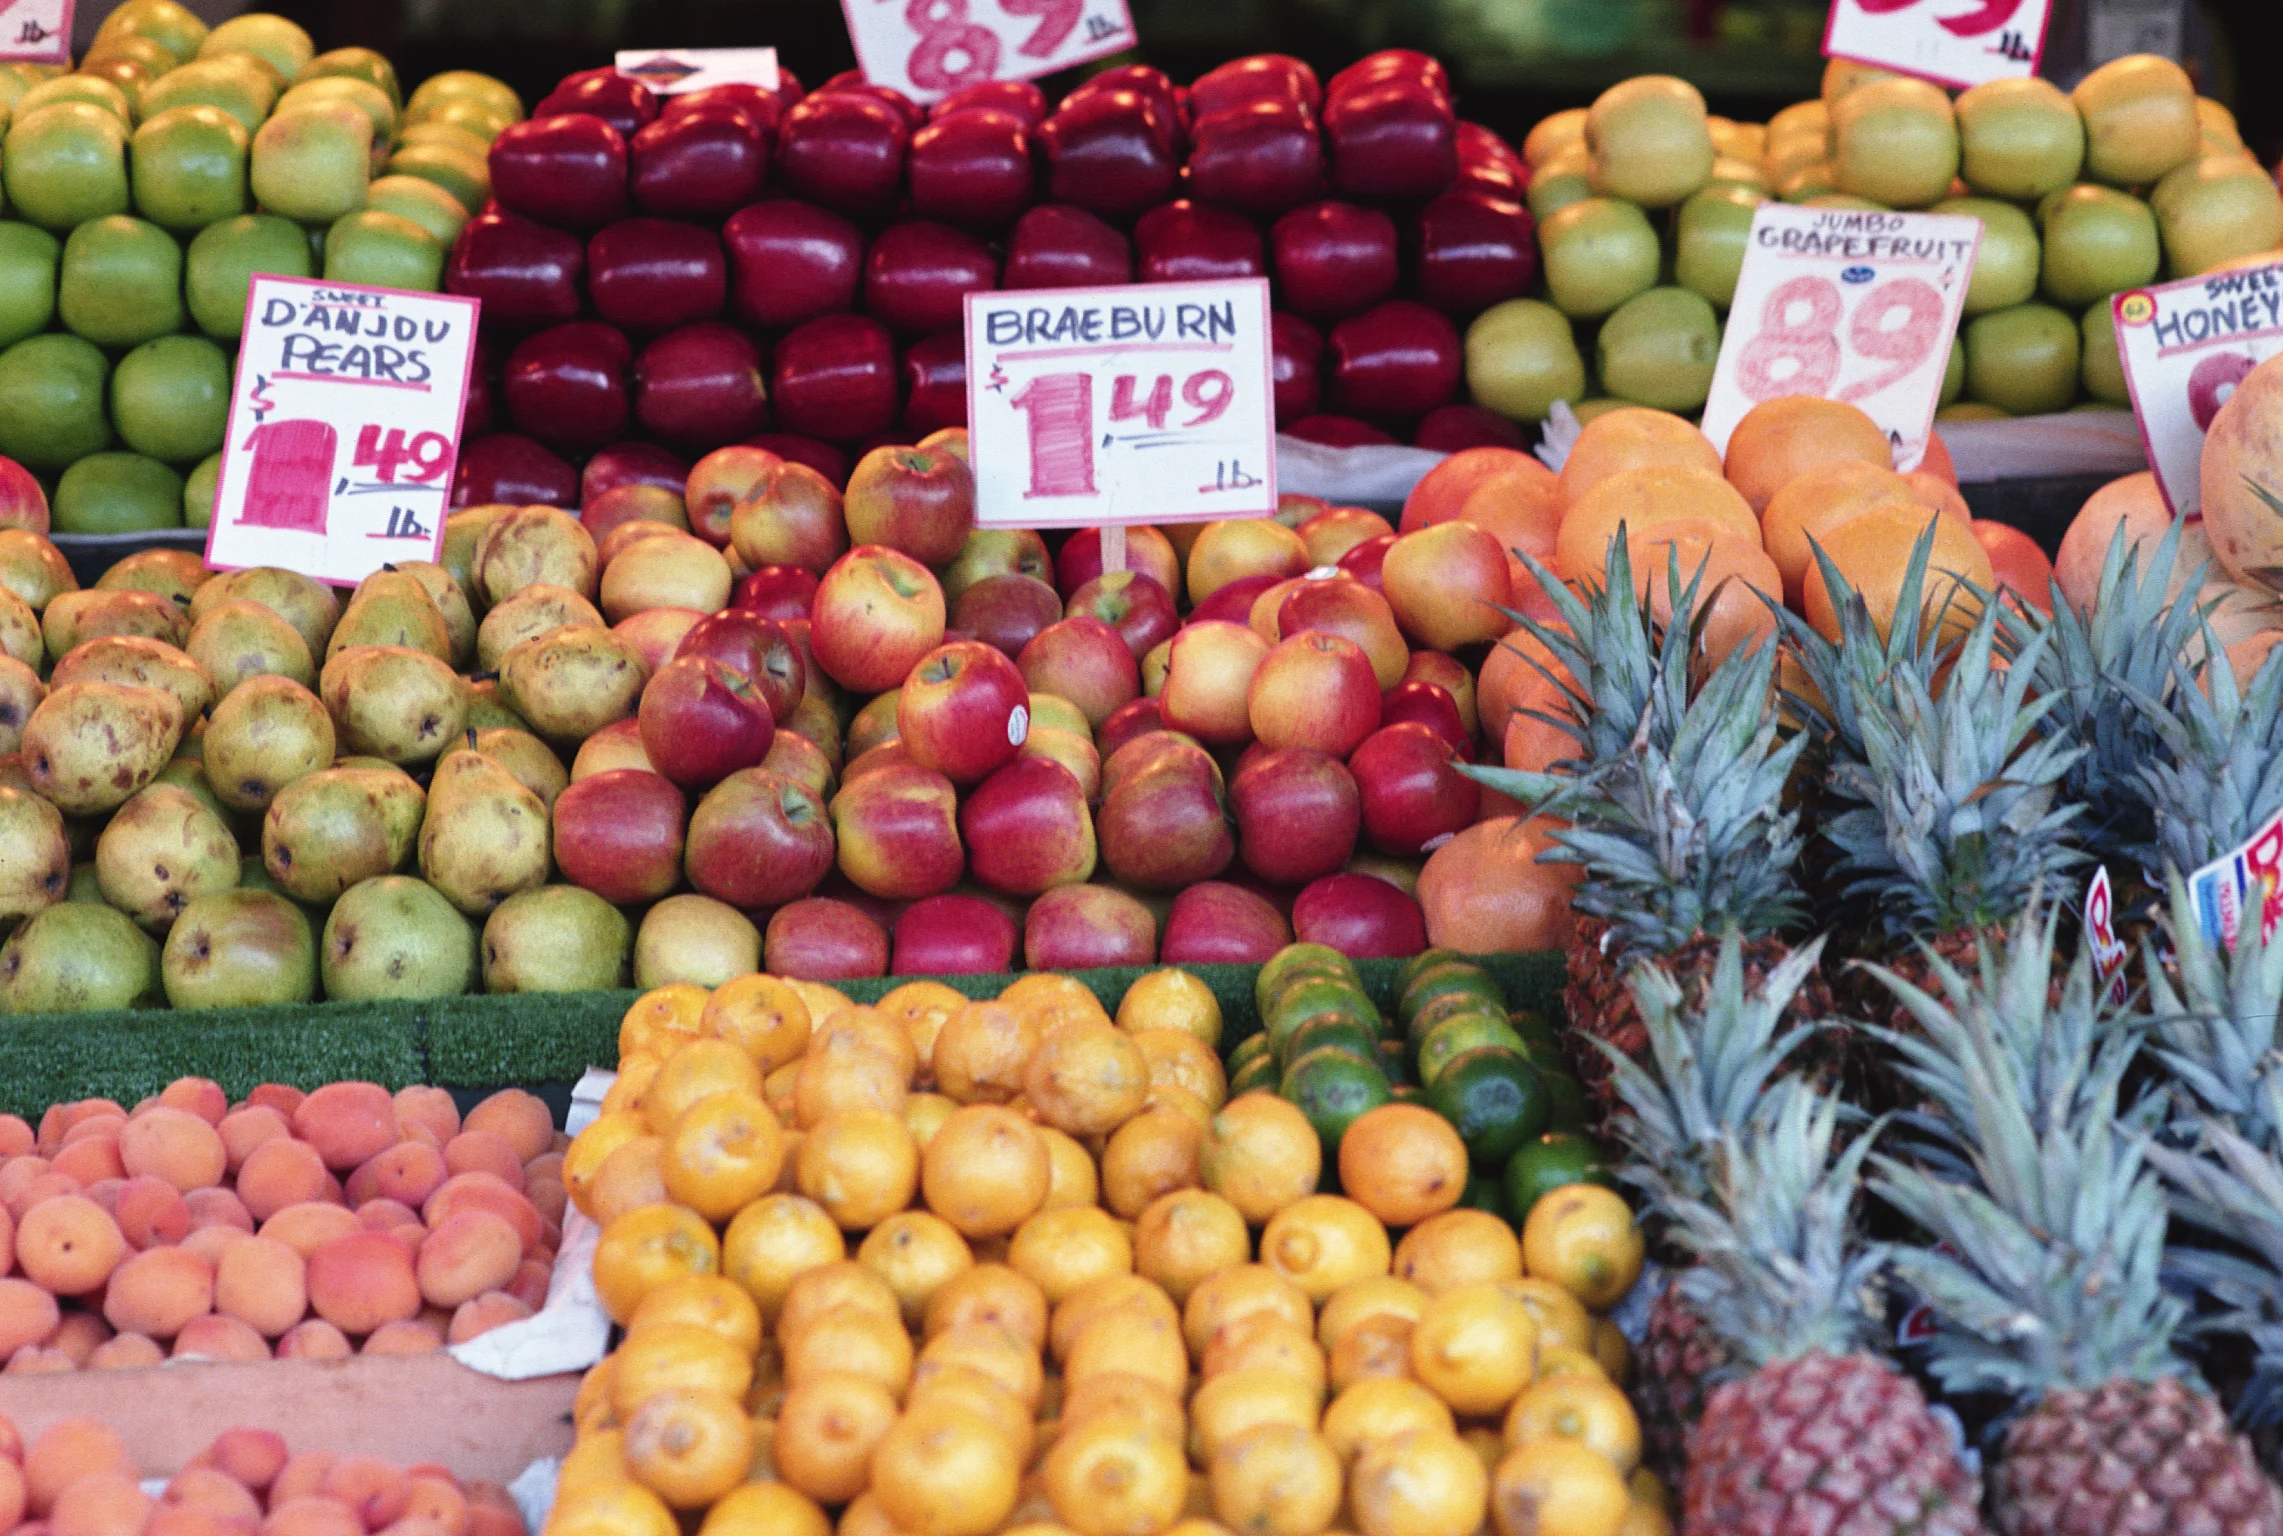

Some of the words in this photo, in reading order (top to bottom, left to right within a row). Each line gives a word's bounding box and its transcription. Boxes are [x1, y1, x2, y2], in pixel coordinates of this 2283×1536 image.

[1813, 212, 1905, 234] JUMBO
[1757, 226, 1970, 261] GRAPEFRUIT
[312, 289, 386, 308] SWEET
[2204, 265, 2283, 300] SWEE
[986, 301, 1236, 345] BRAEBURN
[281, 333, 431, 382] PEARS
